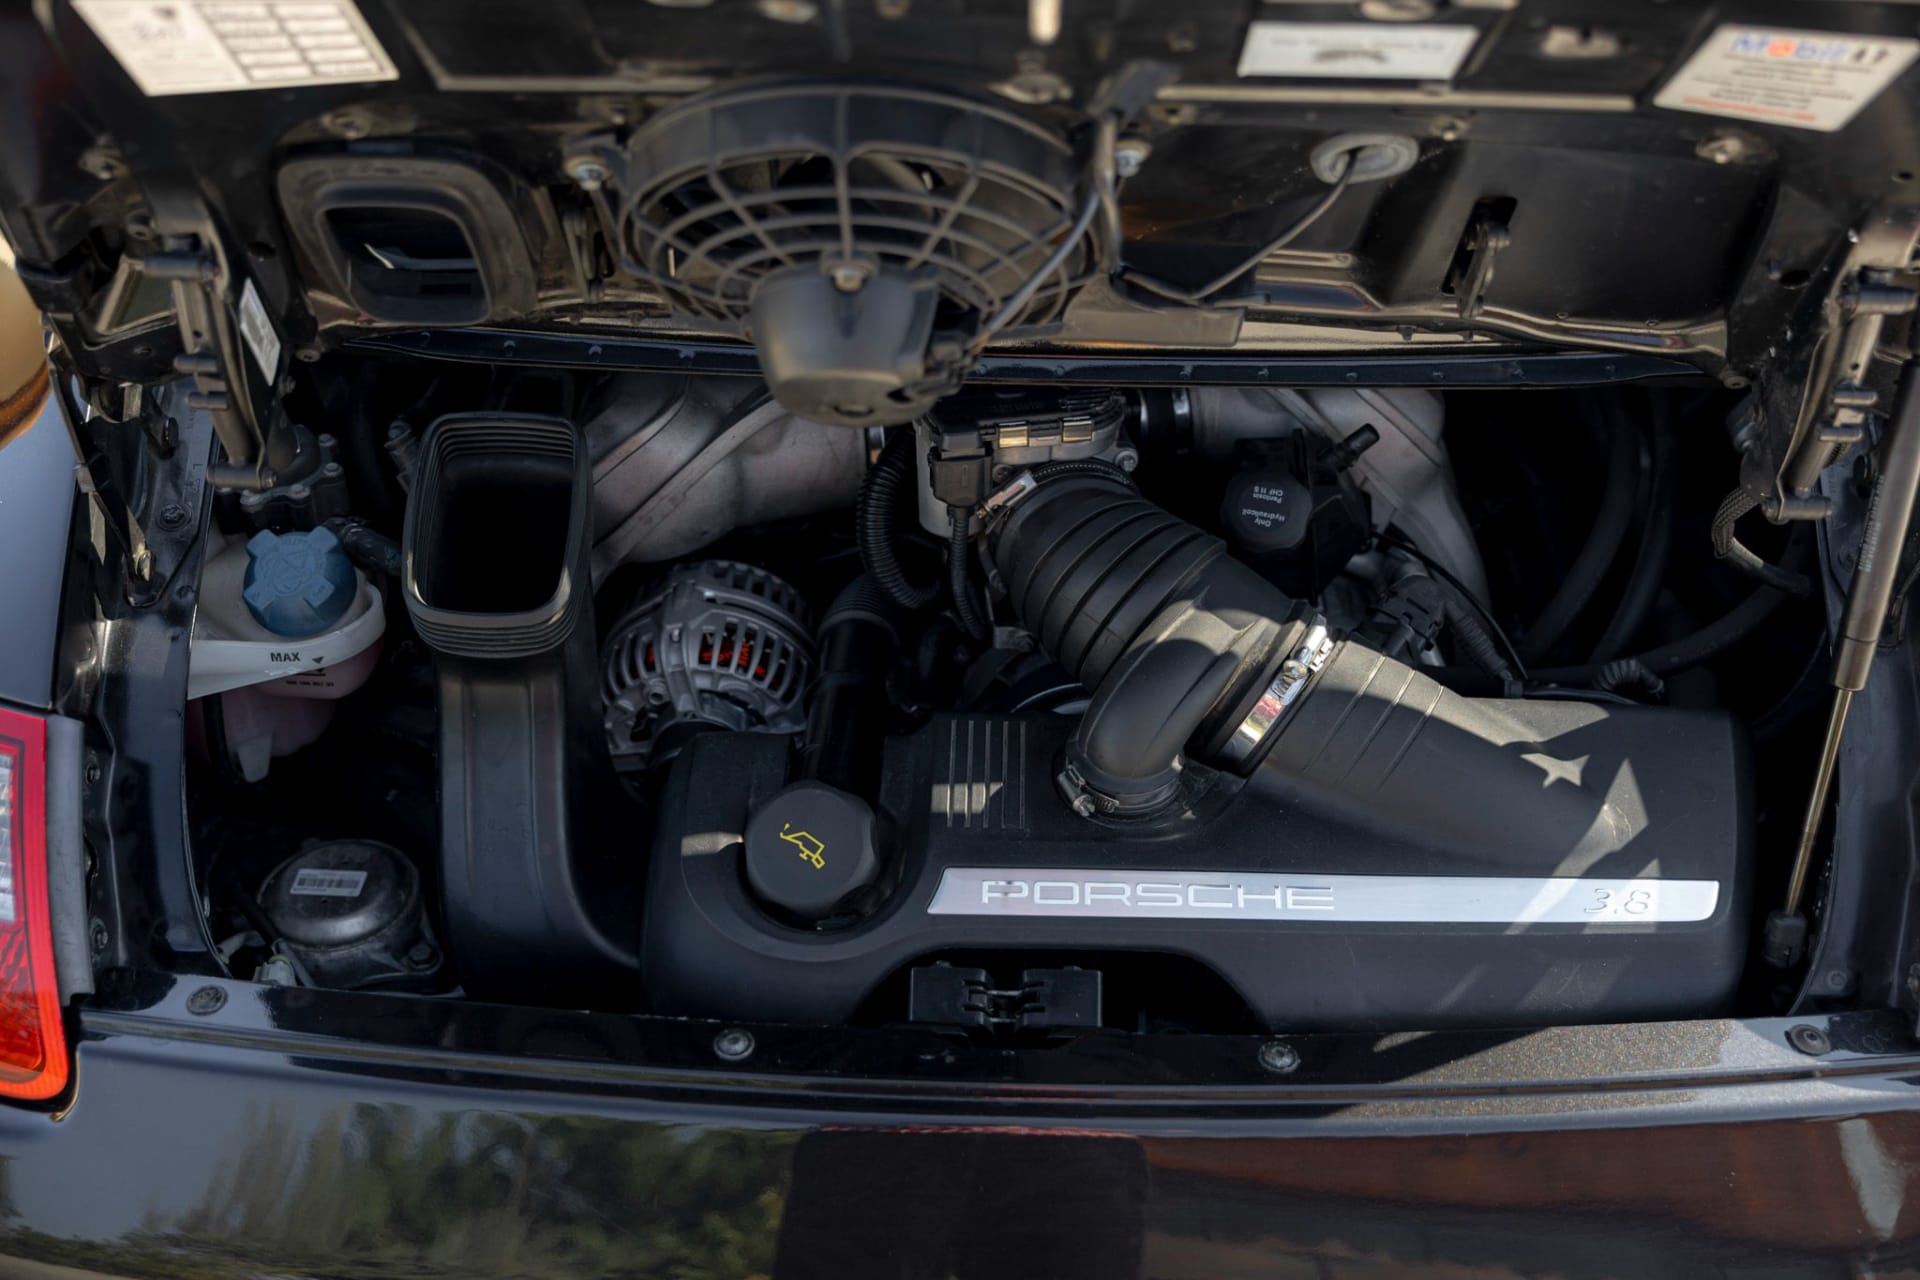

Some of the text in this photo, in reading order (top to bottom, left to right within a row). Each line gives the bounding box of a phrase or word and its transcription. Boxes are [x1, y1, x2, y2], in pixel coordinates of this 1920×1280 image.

[1269, 487, 1284, 497] CHF
[1254, 517, 1272, 528] Only
[270, 652, 301, 662] MAX
[981, 880, 1652, 915] PORSCHE 3.8
